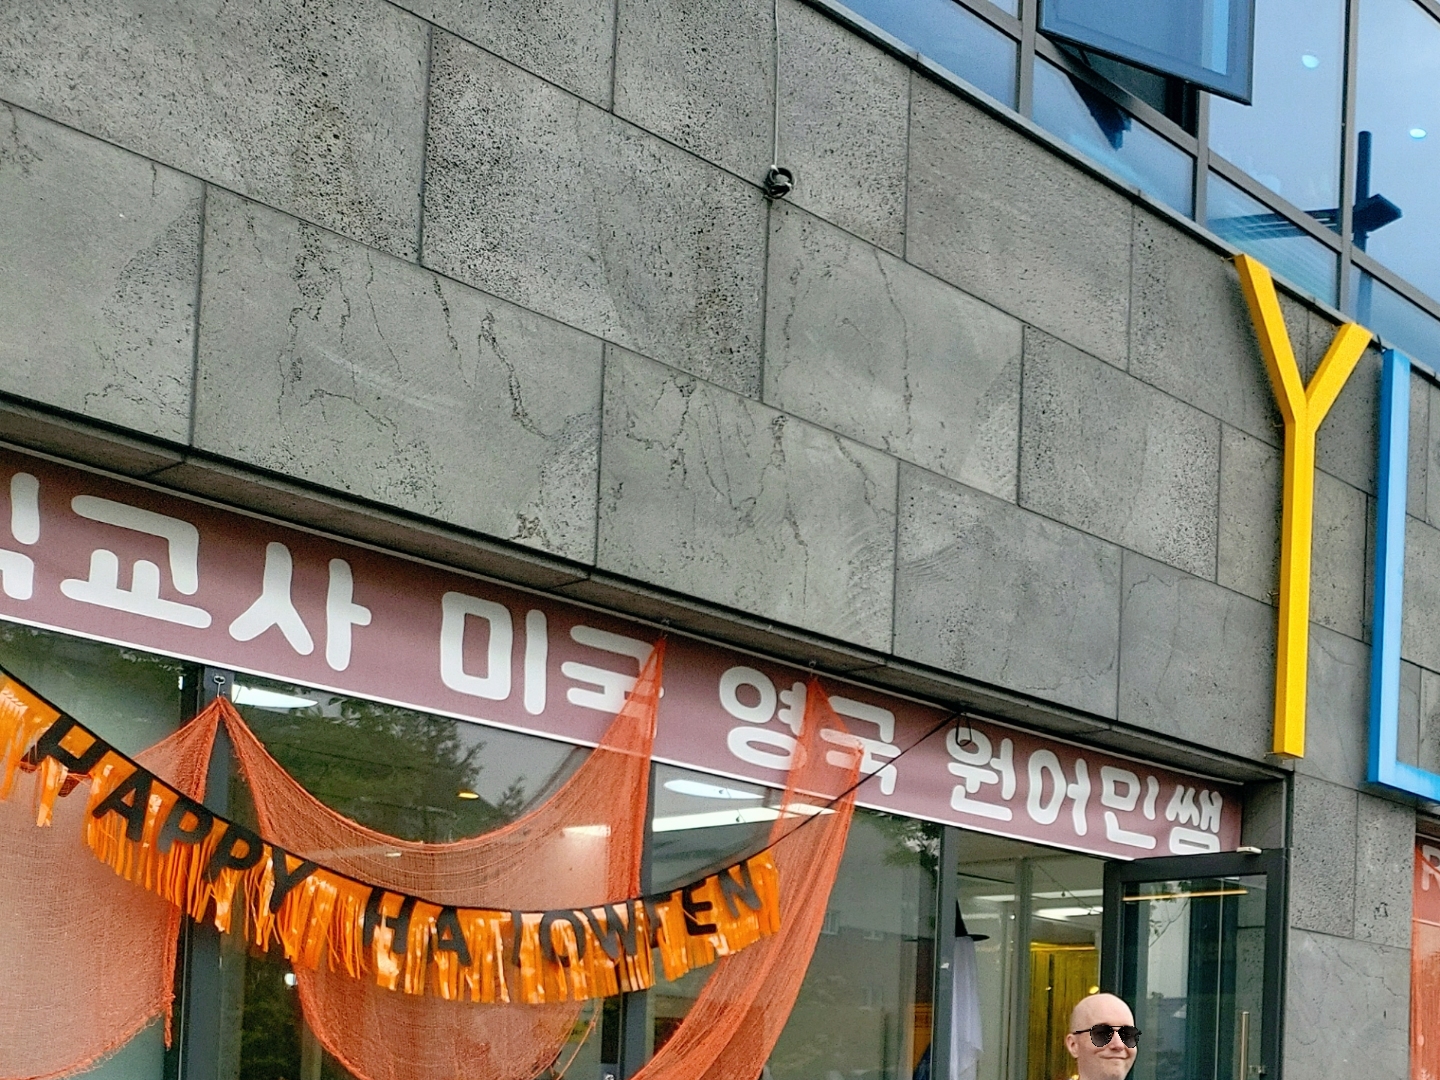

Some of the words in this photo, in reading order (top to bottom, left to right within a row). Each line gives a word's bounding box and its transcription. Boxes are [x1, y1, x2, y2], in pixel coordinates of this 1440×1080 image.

[20, 715, 320, 914] HAPPY
[718, 665, 902, 795] 영국
[946, 726, 1223, 855] 원어민쌤
